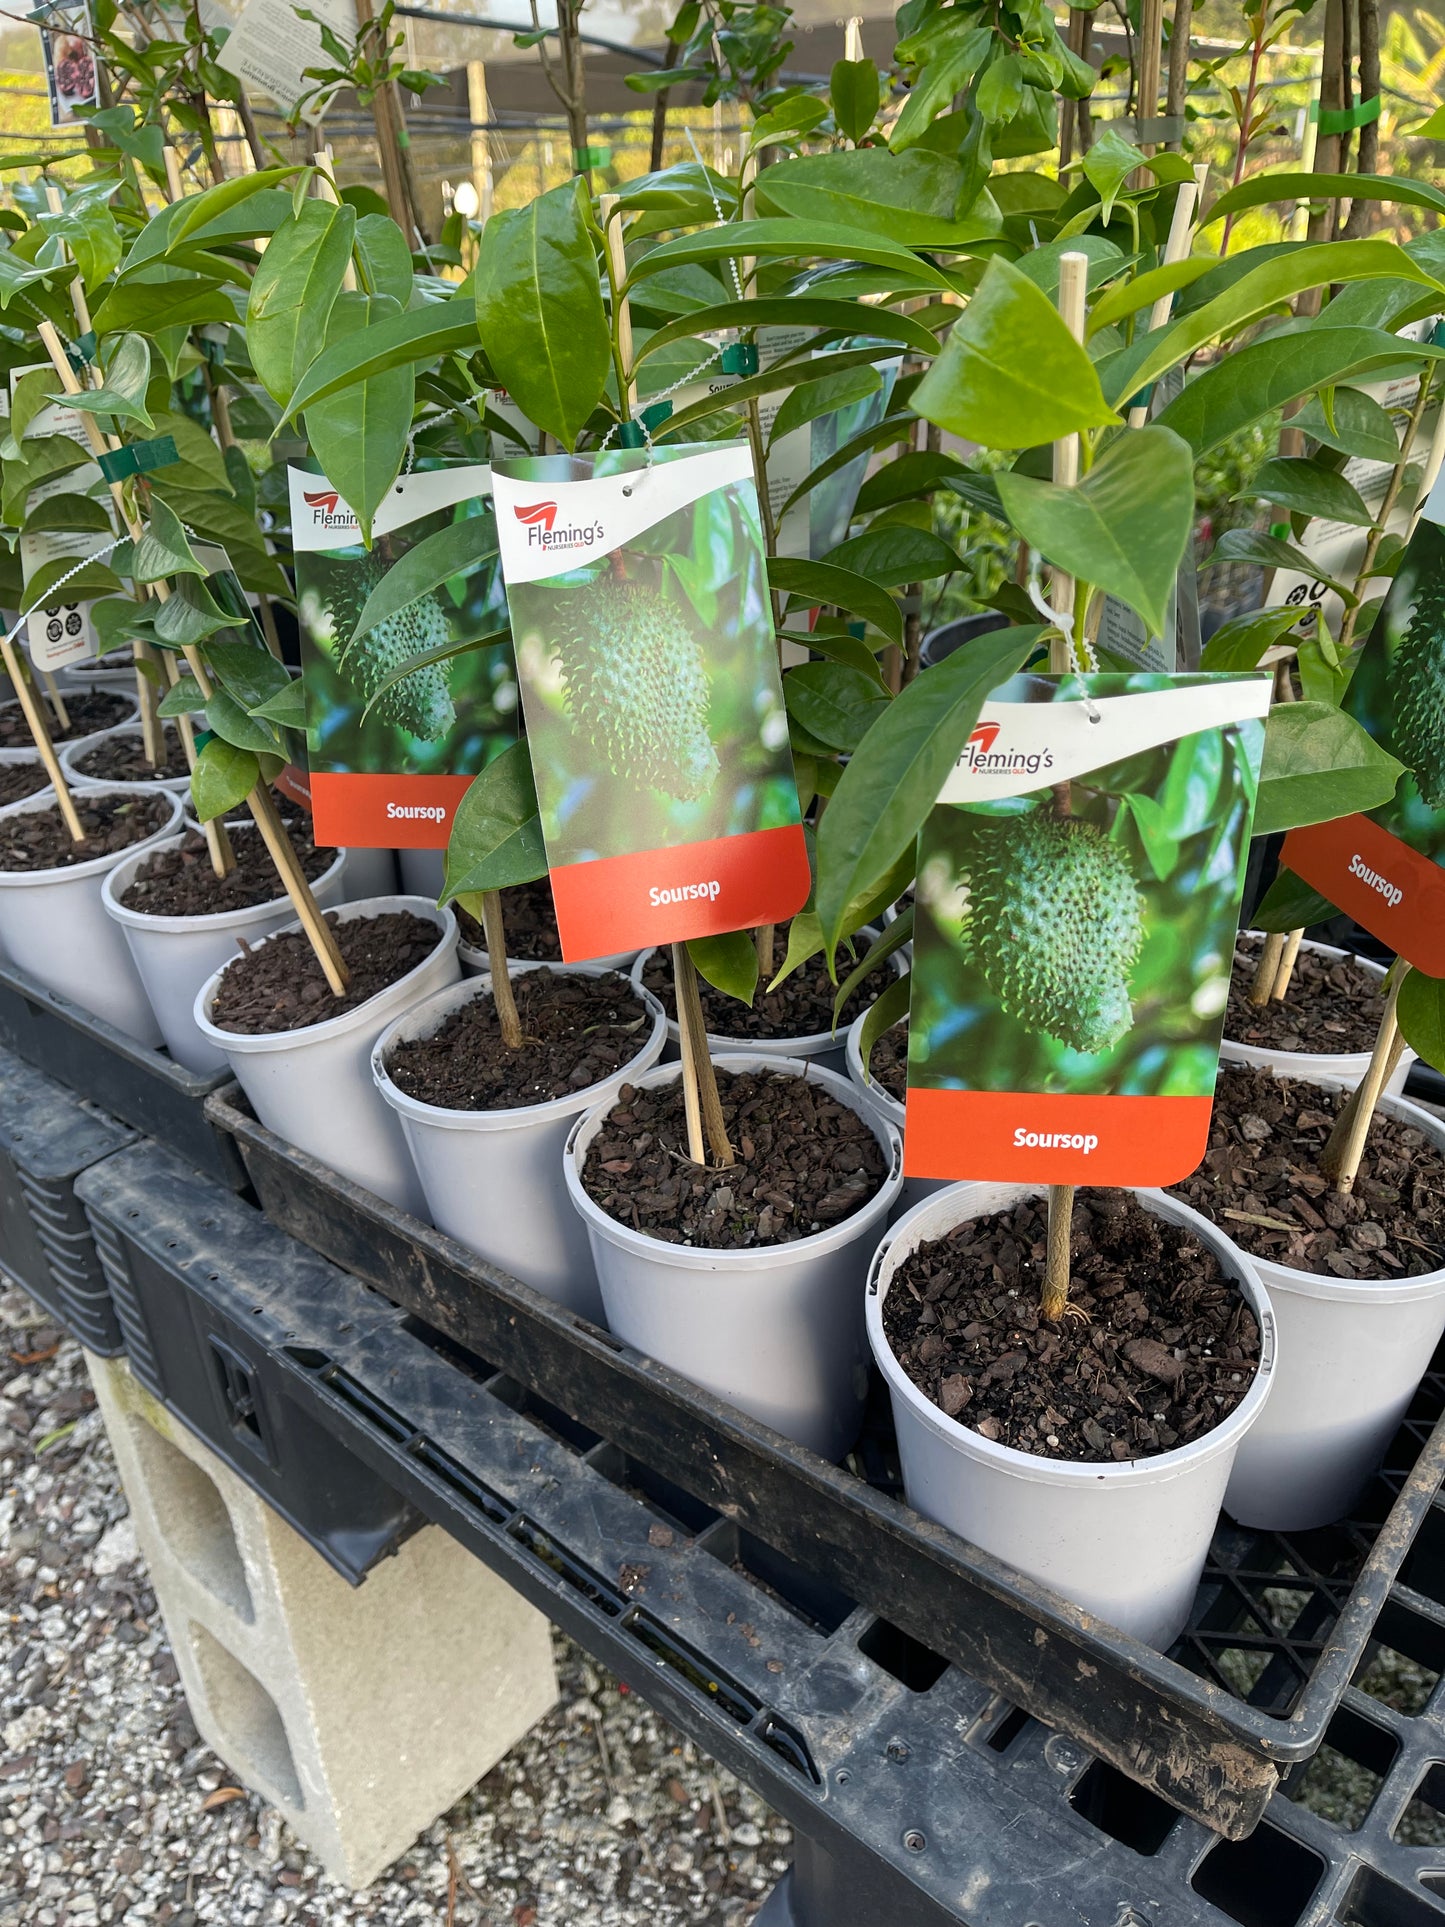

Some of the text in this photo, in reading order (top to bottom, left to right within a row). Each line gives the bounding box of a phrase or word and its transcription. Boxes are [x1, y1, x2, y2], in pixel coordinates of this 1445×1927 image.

[313, 507, 376, 525] Flemin
[528, 520, 605, 546] Fleming's
[547, 541, 585, 551] NURSERIES QLD
[956, 745, 1053, 774] Fleming's
[1012, 767, 1026, 775] QLD
[386, 802, 446, 824] Soursop
[649, 880, 721, 907] Soursop
[1348, 854, 1403, 907] Soursop
[1013, 1127, 1098, 1155] Soursop
